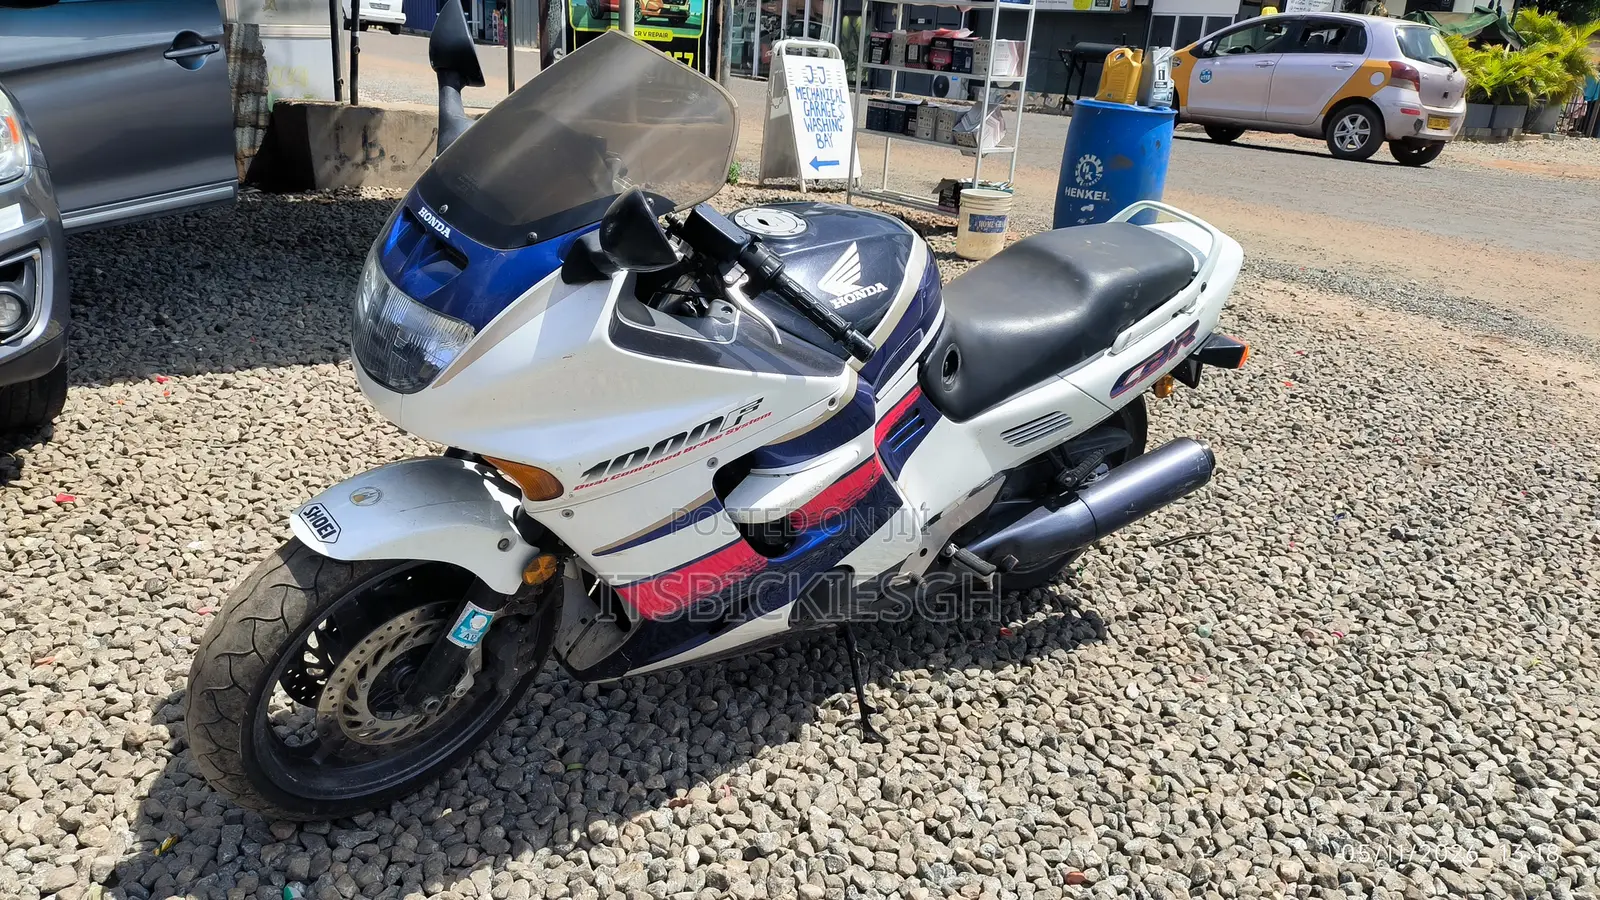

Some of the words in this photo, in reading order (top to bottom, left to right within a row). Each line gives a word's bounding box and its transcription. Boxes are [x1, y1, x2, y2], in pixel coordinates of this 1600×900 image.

[795, 86, 846, 104] MECHANICAL
[803, 117, 843, 132] WASHING
[815, 133, 833, 149] BAY
[1065, 186, 1110, 201] HENKEL
[417, 206, 451, 239] HONDA
[829, 282, 889, 310] HONDA
[573, 477, 608, 491] Dual
[610, 450, 682, 481] Combined
[683, 432, 723, 454] Brake
[725, 411, 773, 436] System
[580, 397, 764, 482] 1000F
[303, 505, 337, 540] SHOEI
